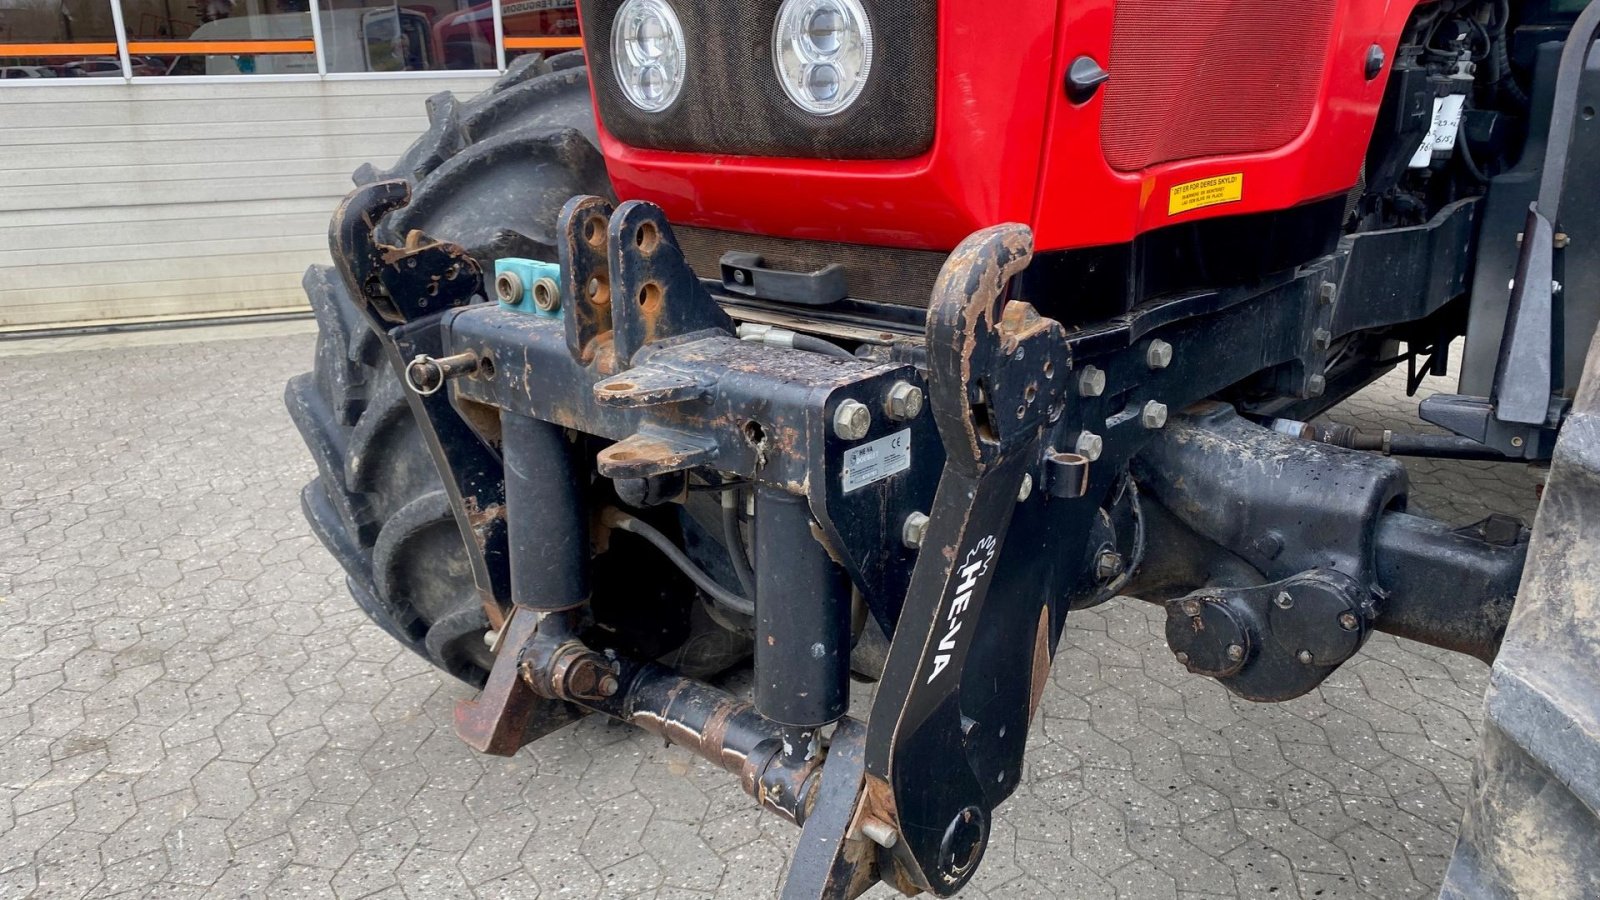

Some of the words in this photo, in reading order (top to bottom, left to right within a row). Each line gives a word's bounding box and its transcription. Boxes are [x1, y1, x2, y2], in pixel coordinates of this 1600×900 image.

[1190, 182, 1200, 191] FOR
[1200, 179, 1217, 188] DERES
[927, 560, 983, 685] HE-VA
